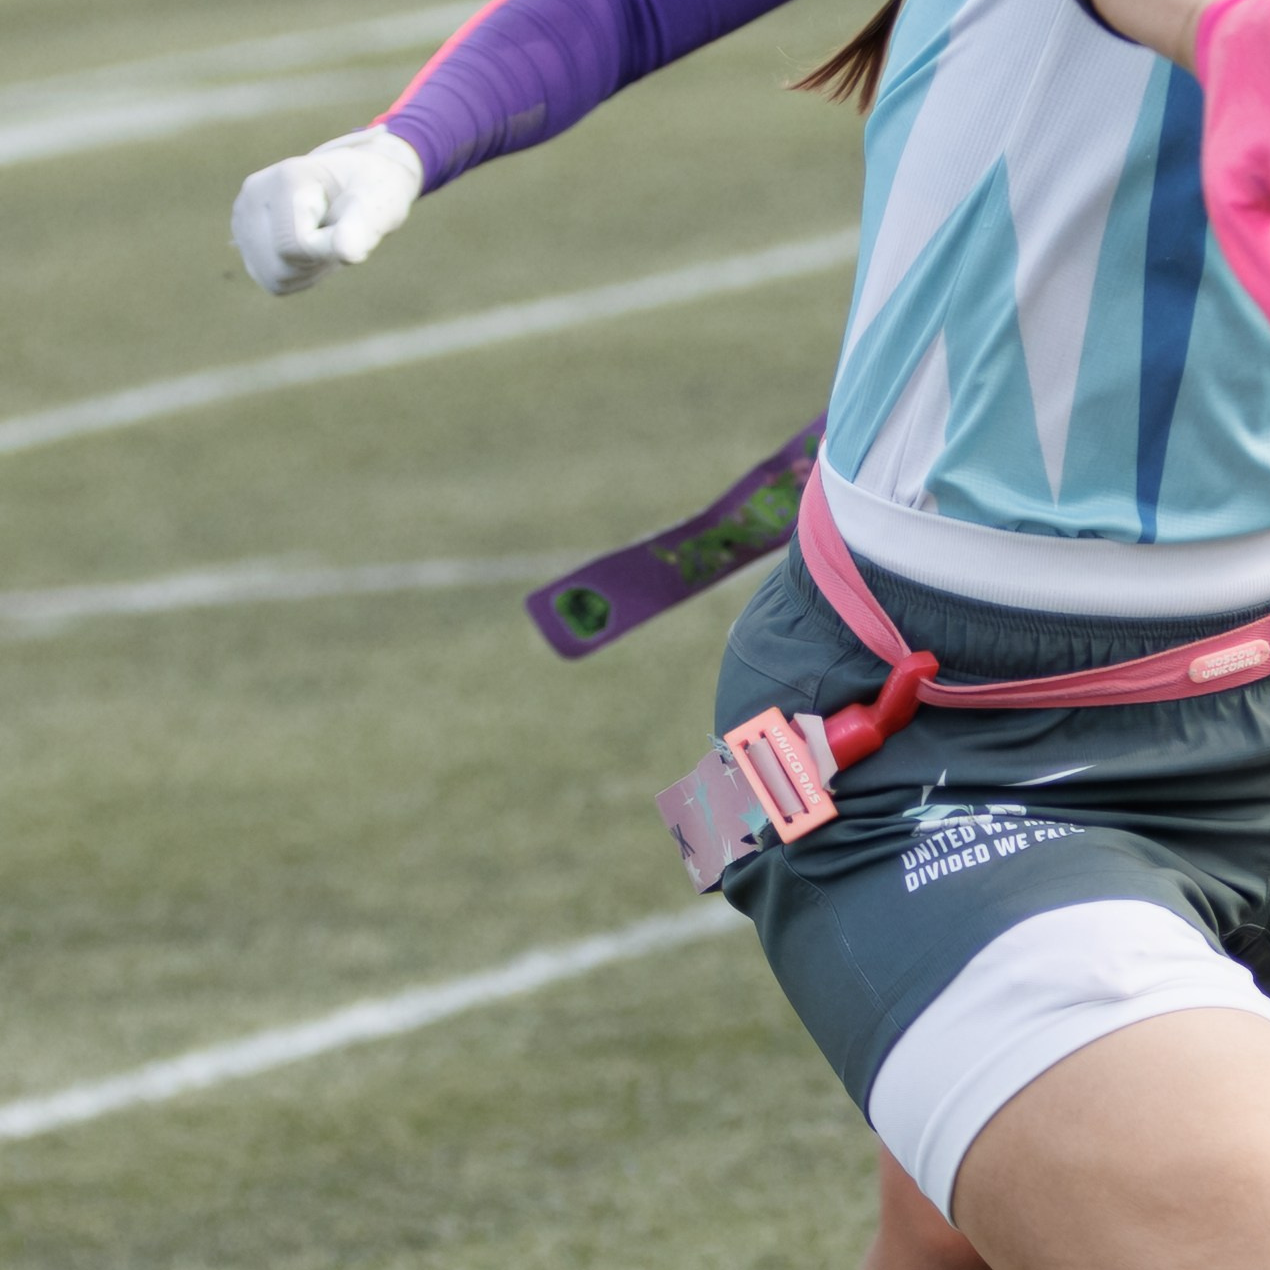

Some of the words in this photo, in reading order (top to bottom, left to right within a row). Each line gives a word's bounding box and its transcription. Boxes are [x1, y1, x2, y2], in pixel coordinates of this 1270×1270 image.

[1202, 655, 1261, 679] UNICORNS
[771, 726, 822, 806] UNICORNS
[901, 825, 976, 870] UNITED
[905, 843, 991, 893] DIVIDED
[993, 832, 1030, 859] WE
